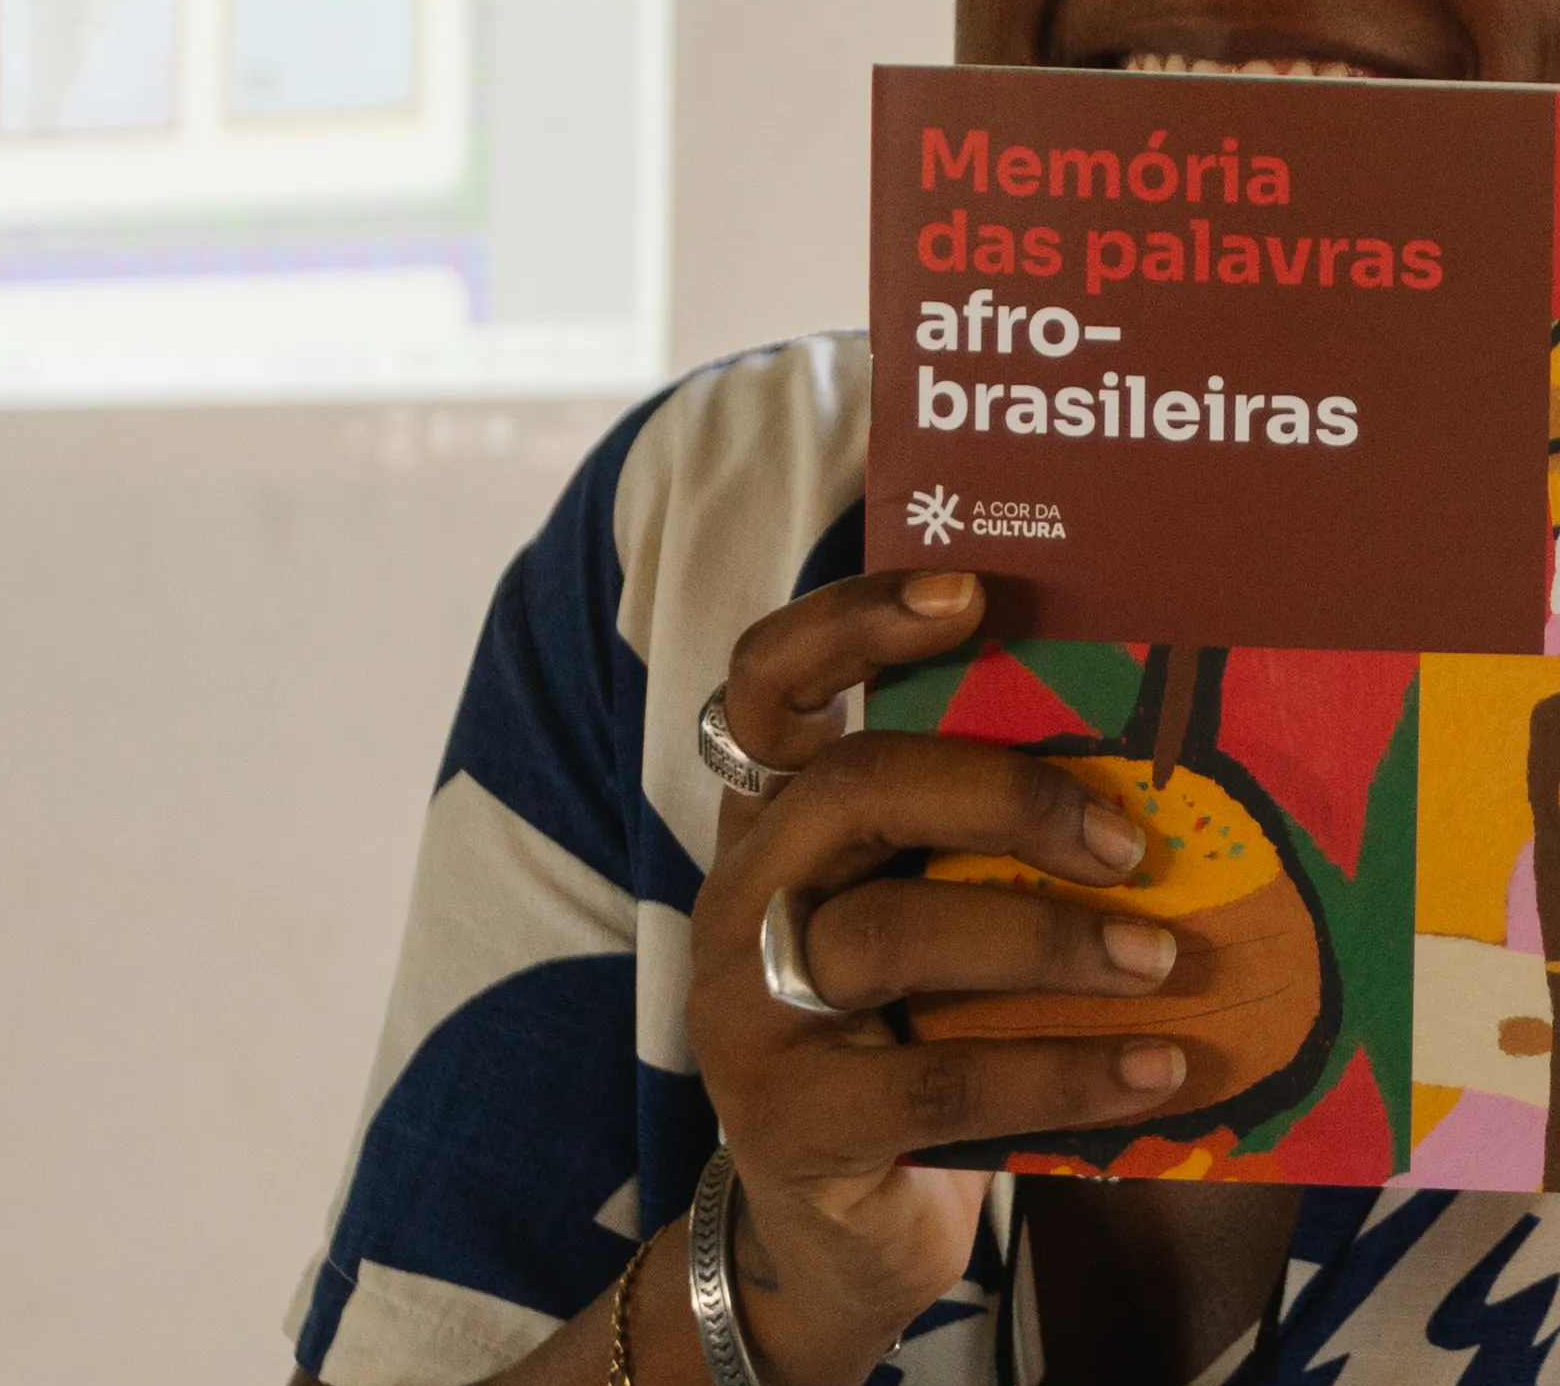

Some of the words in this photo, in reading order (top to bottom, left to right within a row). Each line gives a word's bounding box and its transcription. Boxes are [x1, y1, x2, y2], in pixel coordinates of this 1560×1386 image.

[919, 126, 1293, 206] Memória
[915, 208, 1064, 279] das
[1083, 218, 1444, 296] palavras
[915, 288, 1123, 359] afro-
[916, 365, 1360, 448] brasileiras
[971, 518, 1068, 540] CULTURA
[972, 500, 986, 516] A
[990, 501, 1031, 520] COR
[1035, 503, 1062, 521] DA
